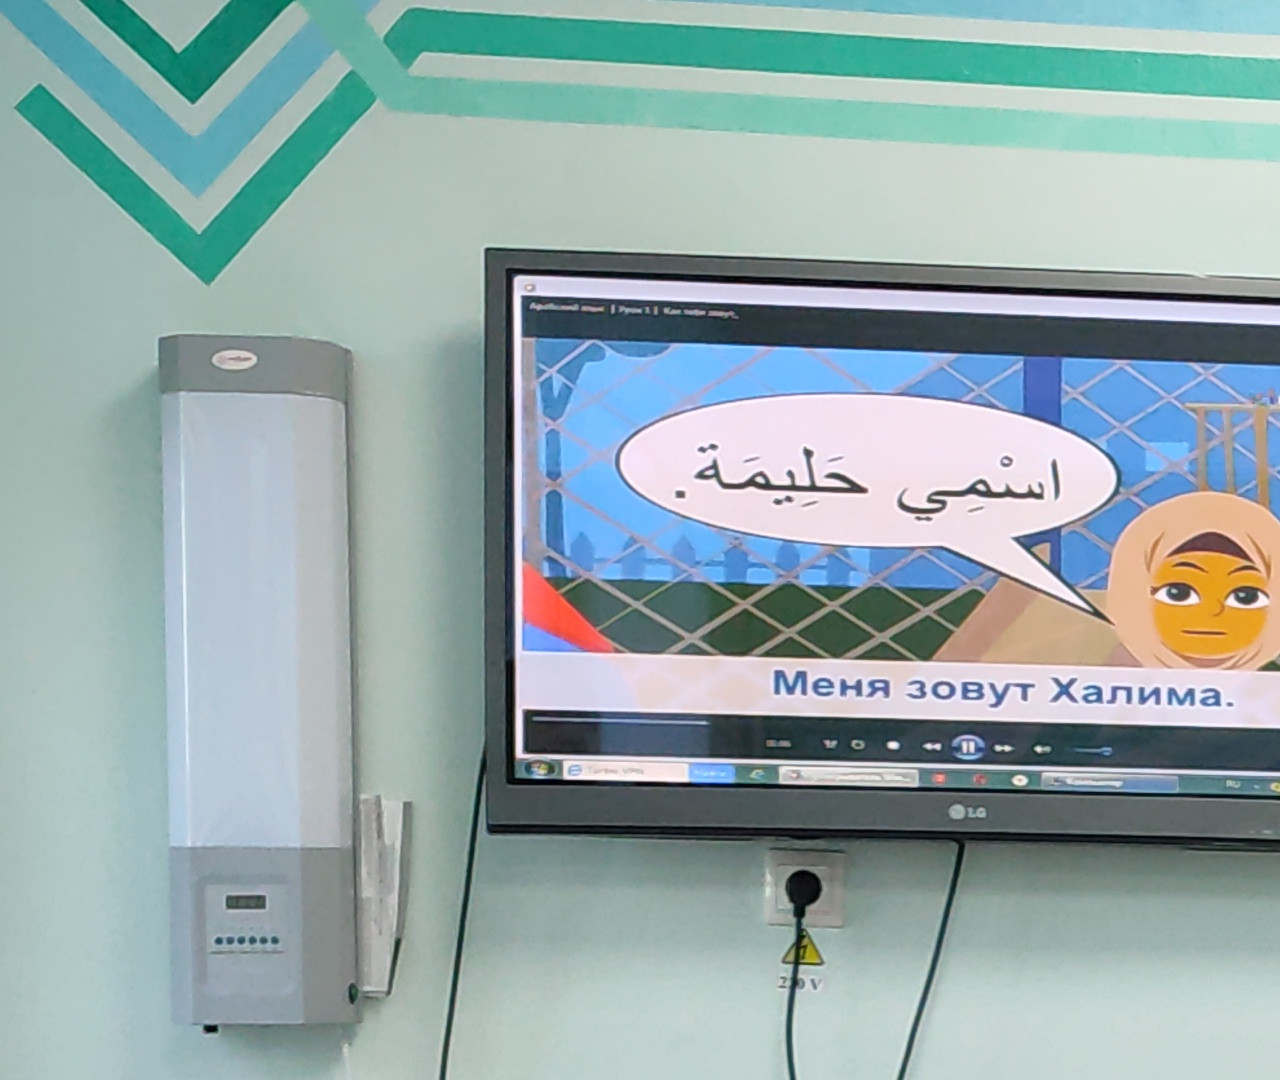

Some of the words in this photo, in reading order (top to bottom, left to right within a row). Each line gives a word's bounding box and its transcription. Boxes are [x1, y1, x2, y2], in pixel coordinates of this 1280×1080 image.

[771, 668, 892, 699] Меня
[905, 680, 1036, 709] зовут
[1048, 677, 1236, 708] Халима.
